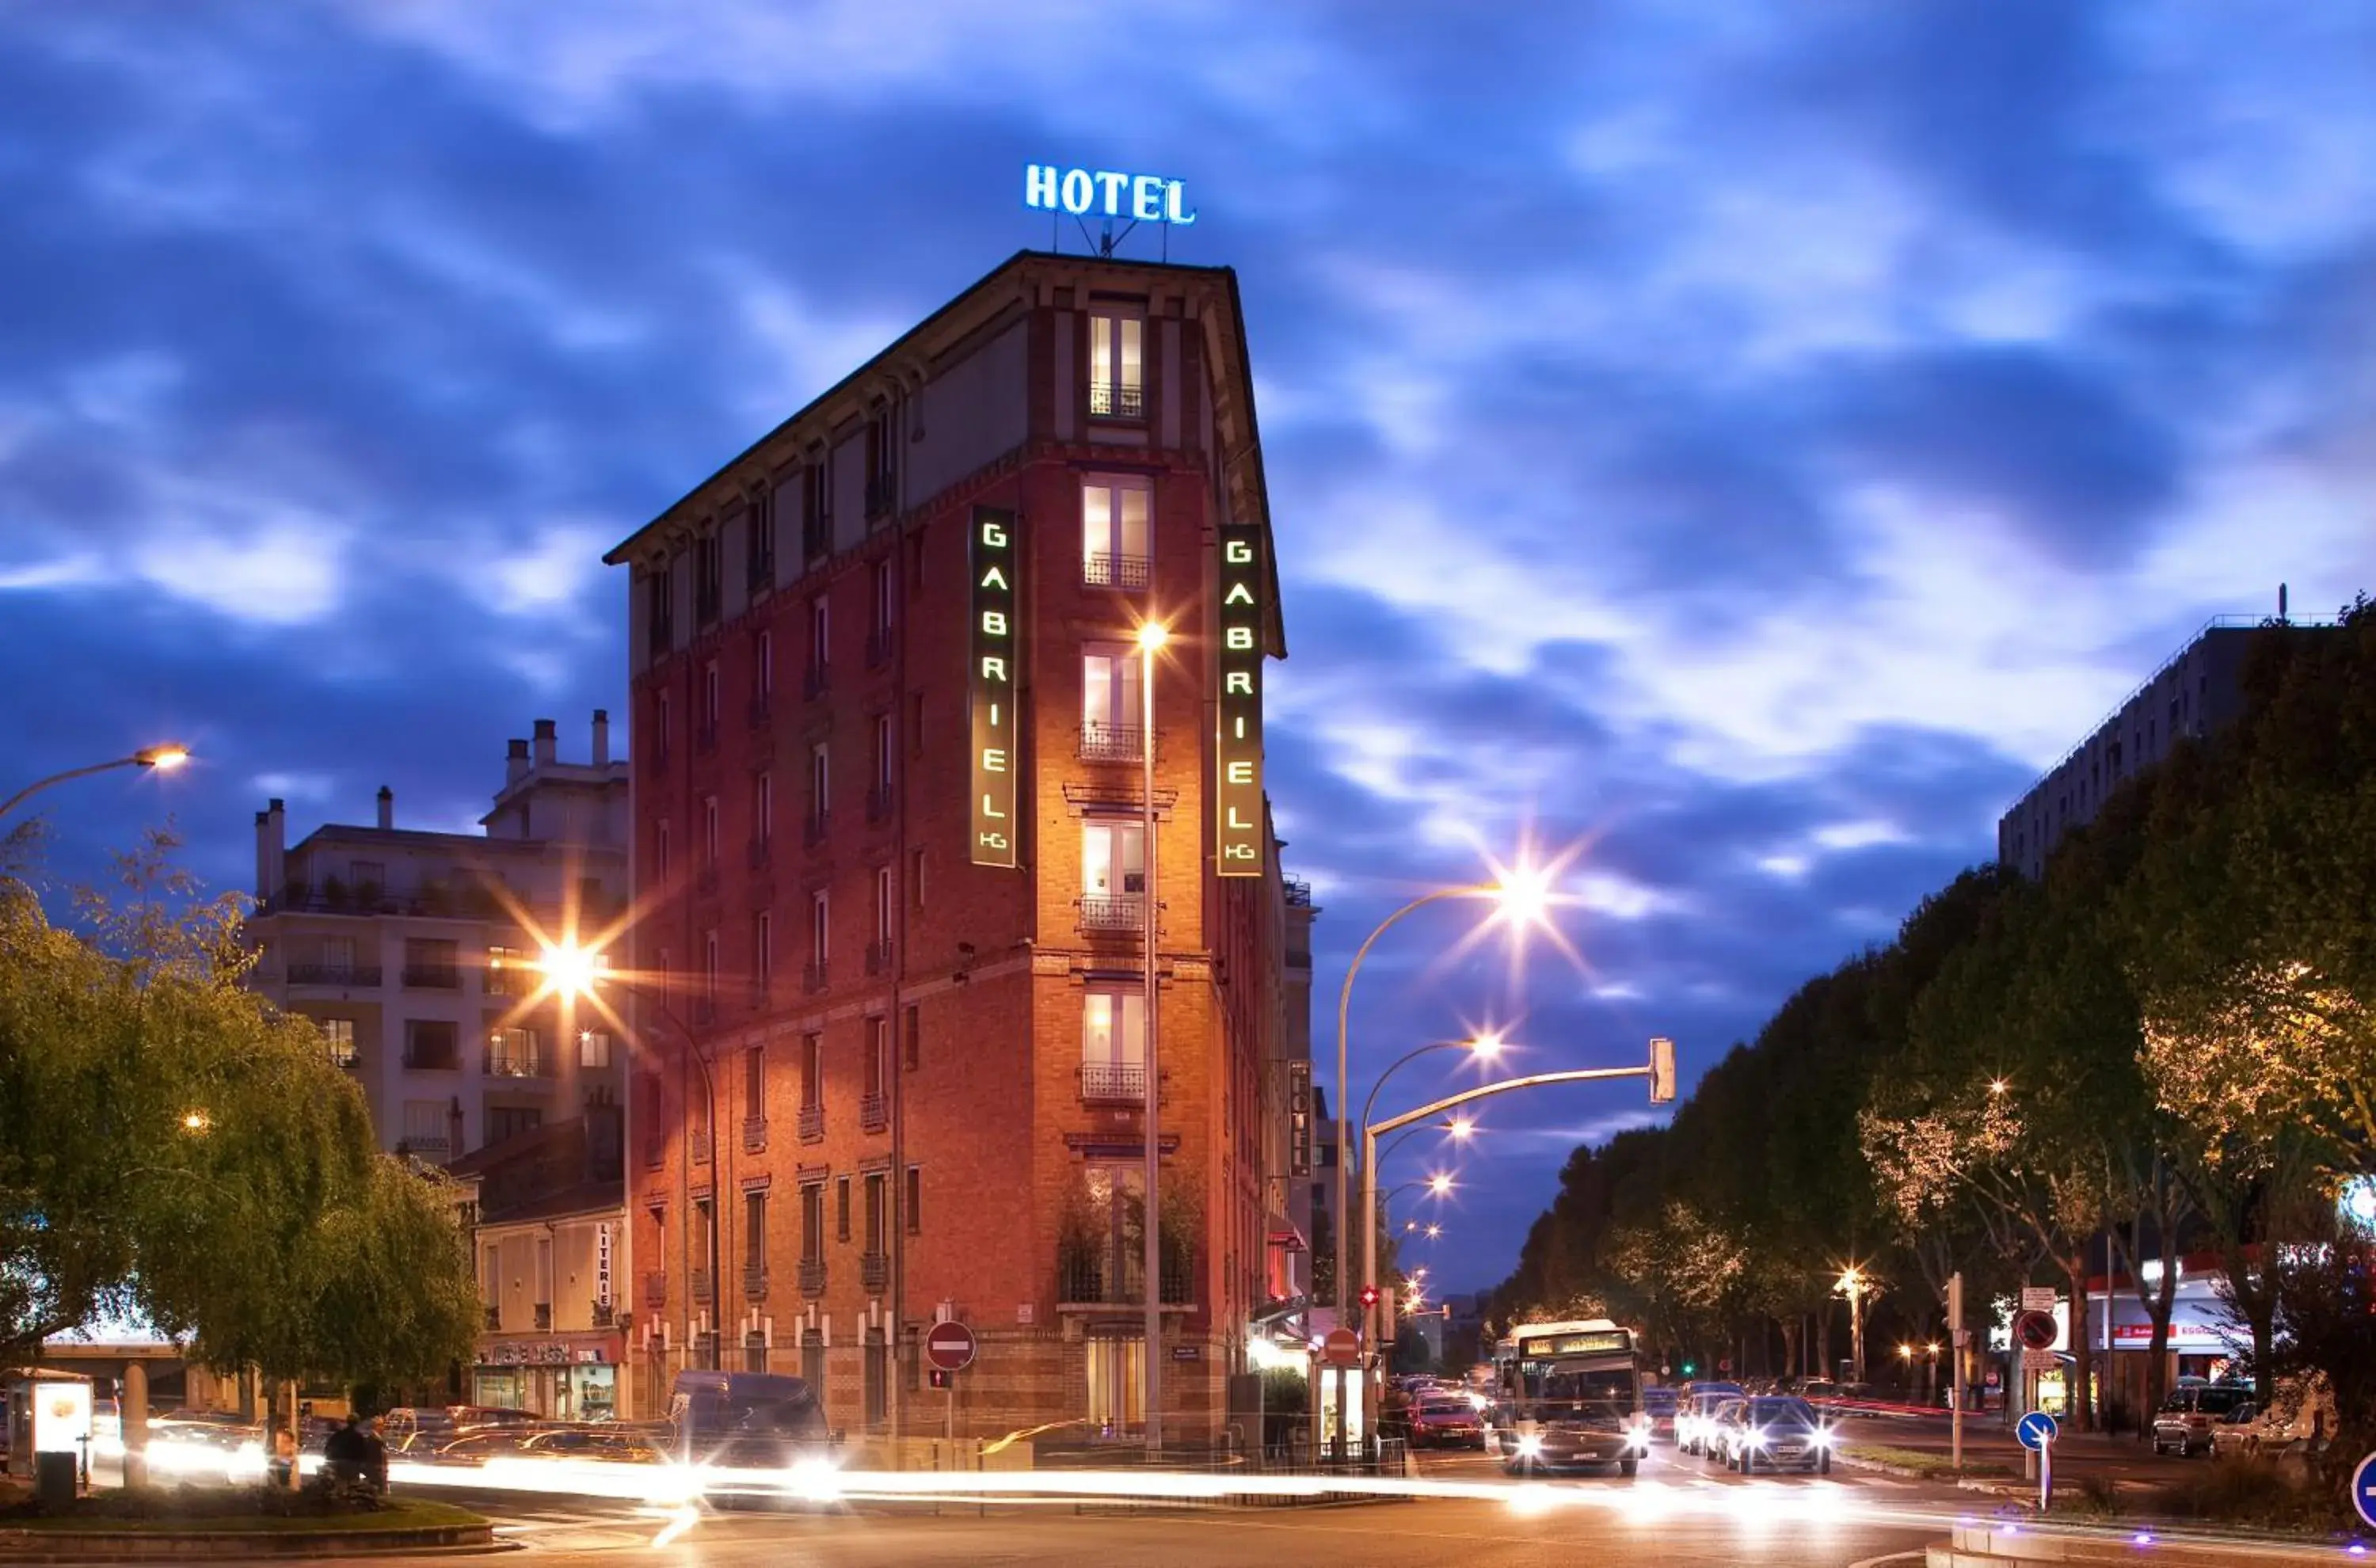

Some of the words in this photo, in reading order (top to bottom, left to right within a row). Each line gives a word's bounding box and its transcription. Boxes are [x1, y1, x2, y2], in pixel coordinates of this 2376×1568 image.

[1026, 164, 1196, 225] HOTEL
[981, 523, 1007, 818] GABRIEL
[1225, 540, 1255, 829] GABRIEL
[1292, 1076, 1308, 1166] HOTEL
[600, 1224, 609, 1304] LITERIE
